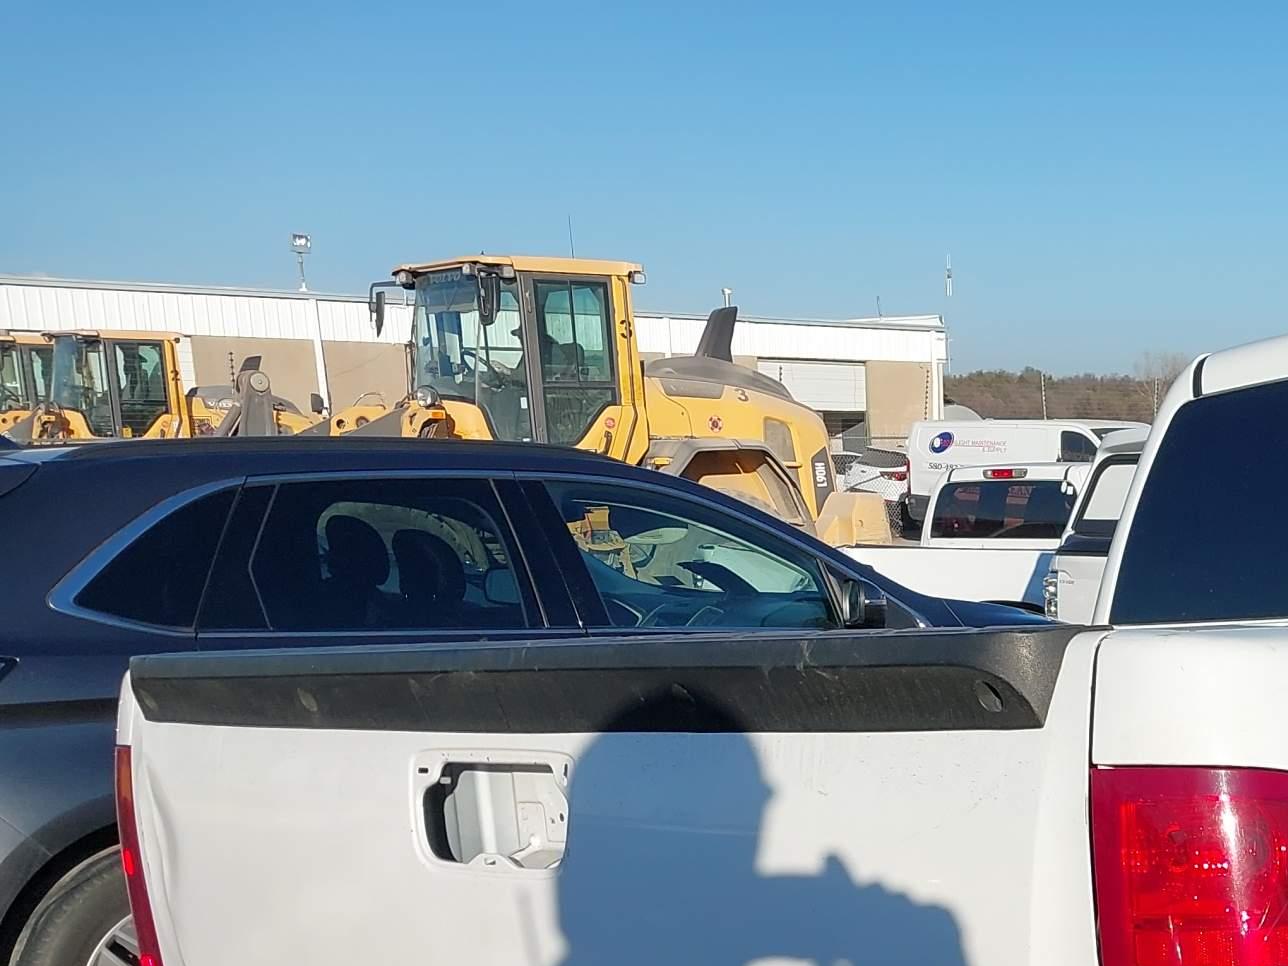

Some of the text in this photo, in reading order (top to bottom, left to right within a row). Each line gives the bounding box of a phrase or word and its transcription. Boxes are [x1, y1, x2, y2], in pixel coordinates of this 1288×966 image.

[619, 319, 633, 339] 3
[734, 388, 749, 402] 3
[814, 462, 828, 487] L90H
